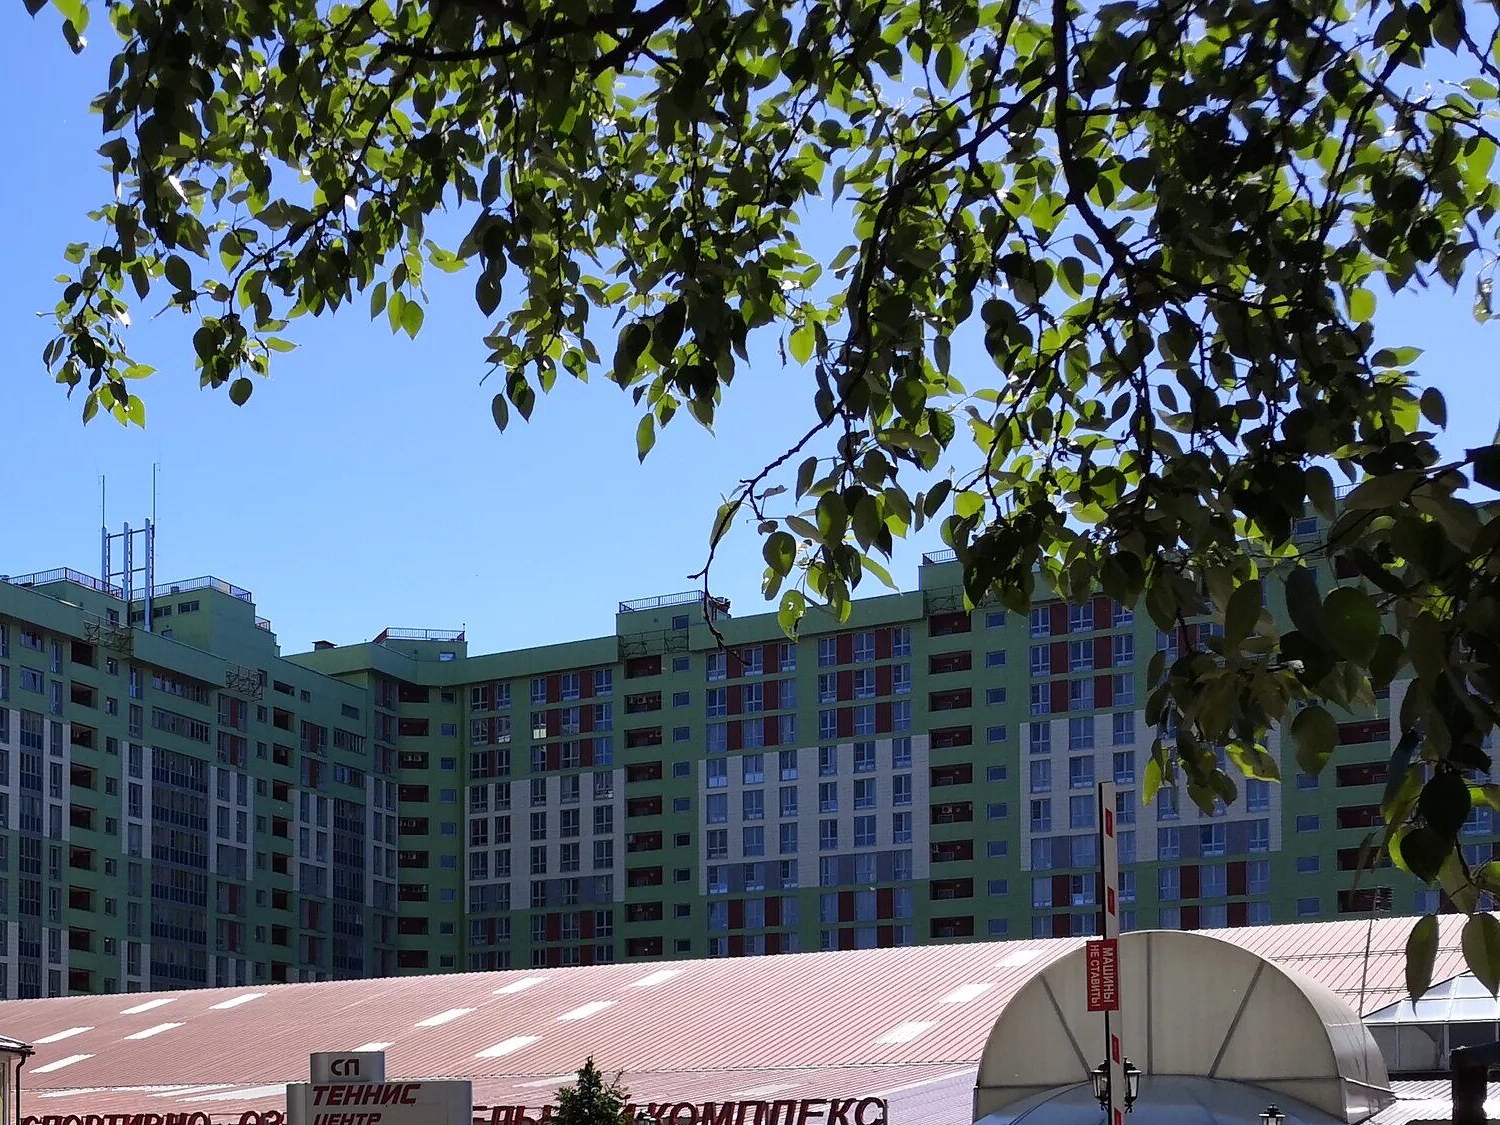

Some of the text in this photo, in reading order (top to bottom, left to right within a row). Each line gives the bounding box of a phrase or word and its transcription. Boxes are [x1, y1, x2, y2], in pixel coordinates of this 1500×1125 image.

[1090, 944, 1100, 958] НЕ
[1102, 947, 1114, 1003] МАШИНЫ
[330, 1059, 360, 1076] СП
[313, 1083, 421, 1106] ТЕННИС
